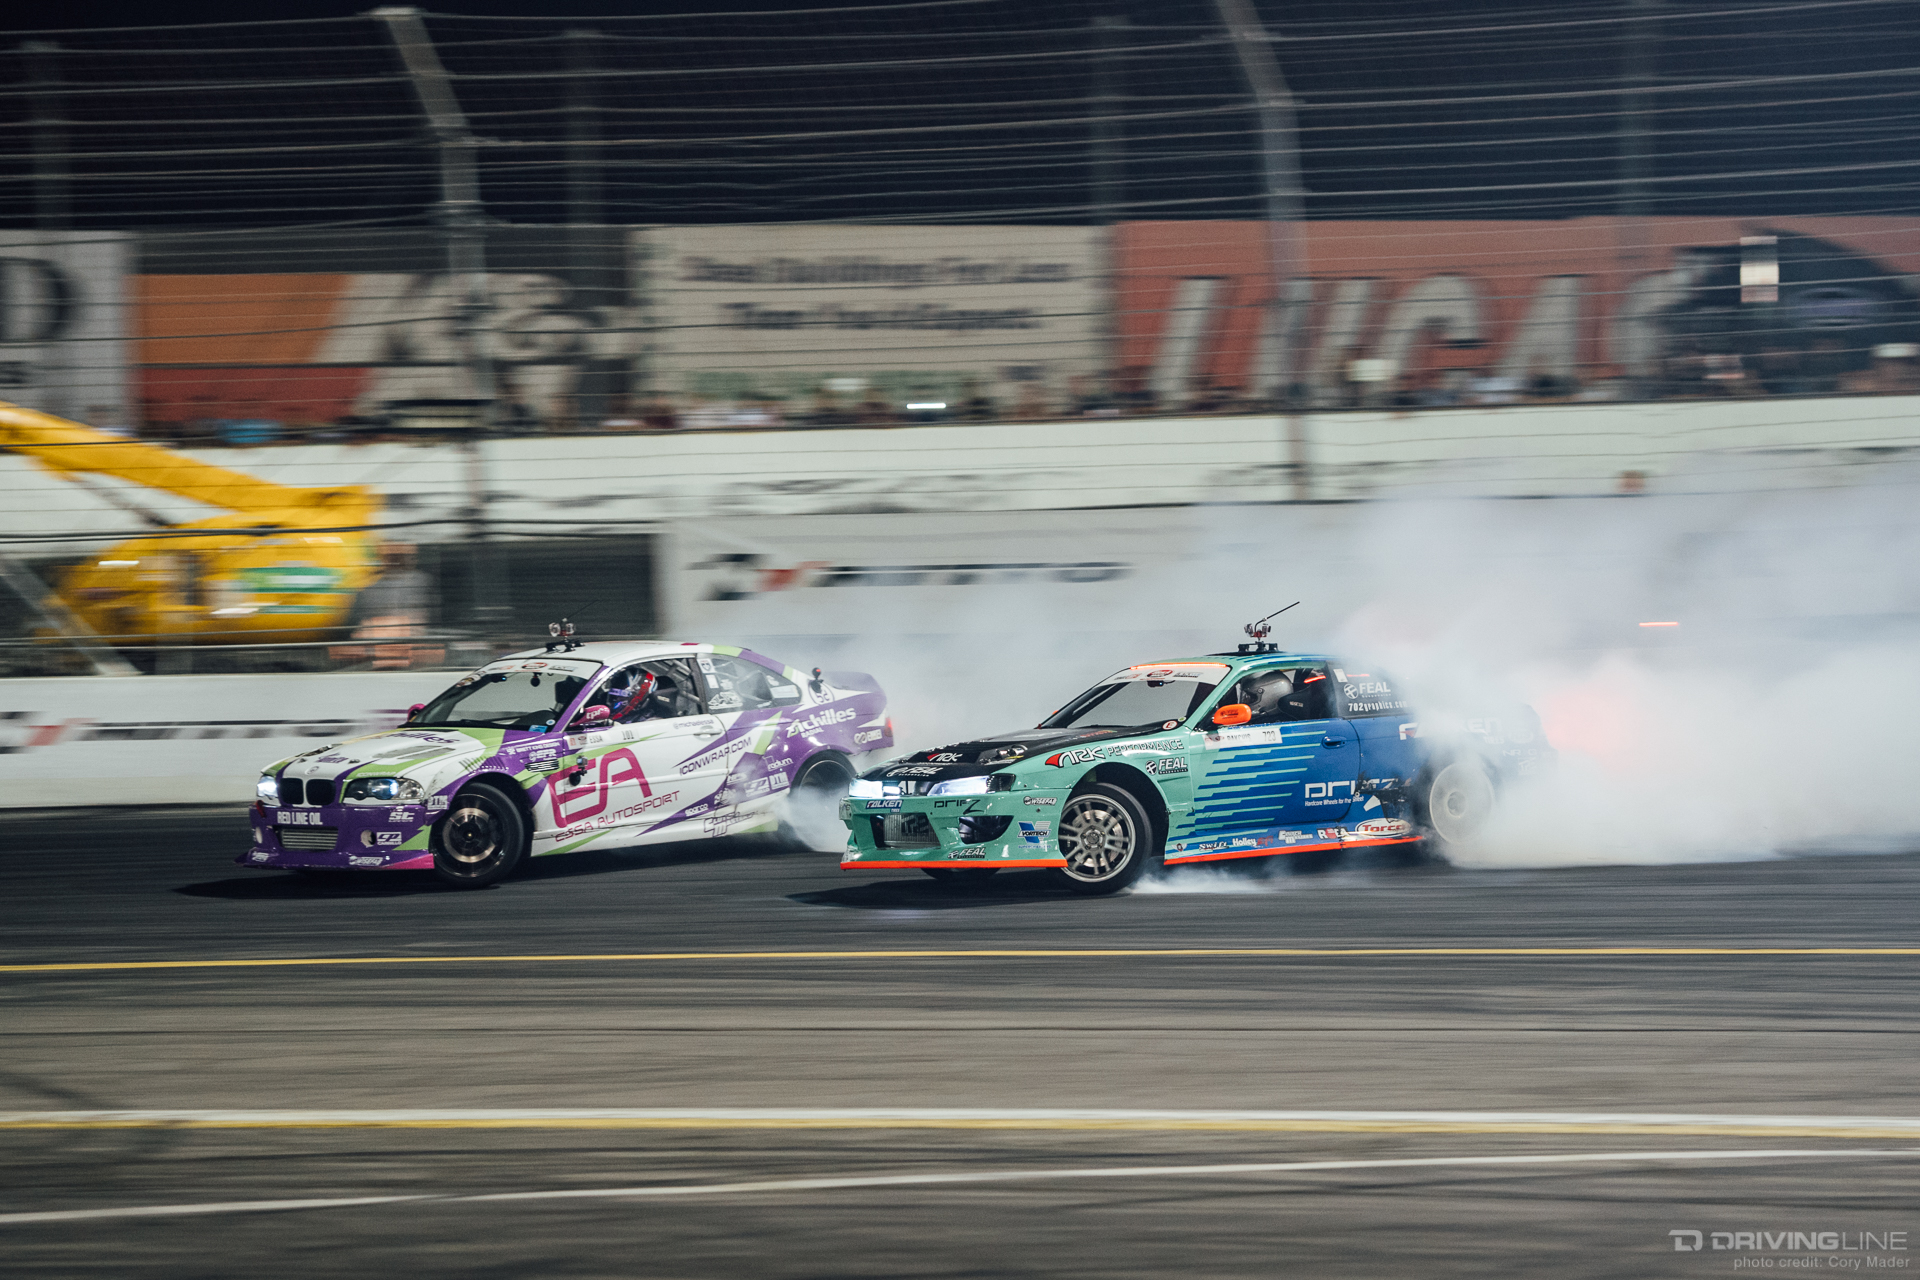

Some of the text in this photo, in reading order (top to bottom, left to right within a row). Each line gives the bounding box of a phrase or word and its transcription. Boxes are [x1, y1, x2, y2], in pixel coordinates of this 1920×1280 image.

[1359, 682, 1391, 695] FEAL
[786, 708, 856, 738] Achilles
[621, 730, 635, 741] 101
[801, 727, 824, 738] RADIAL
[1262, 731, 1276, 742] 723
[590, 736, 603, 744] ESSA
[1106, 739, 1184, 757] PERFORMANCE
[679, 737, 753, 776] ICONWRAP.COM
[1158, 757, 1188, 771] FEAL
[685, 803, 708, 816] sparco
[867, 800, 903, 809] FALKEN
[277, 811, 323, 825] RED LINE OIL
[555, 822, 594, 843] ESSA
[597, 790, 680, 829] AUTOSPORT
[1232, 837, 1257, 848] Holley
[959, 847, 987, 856] FEAL
